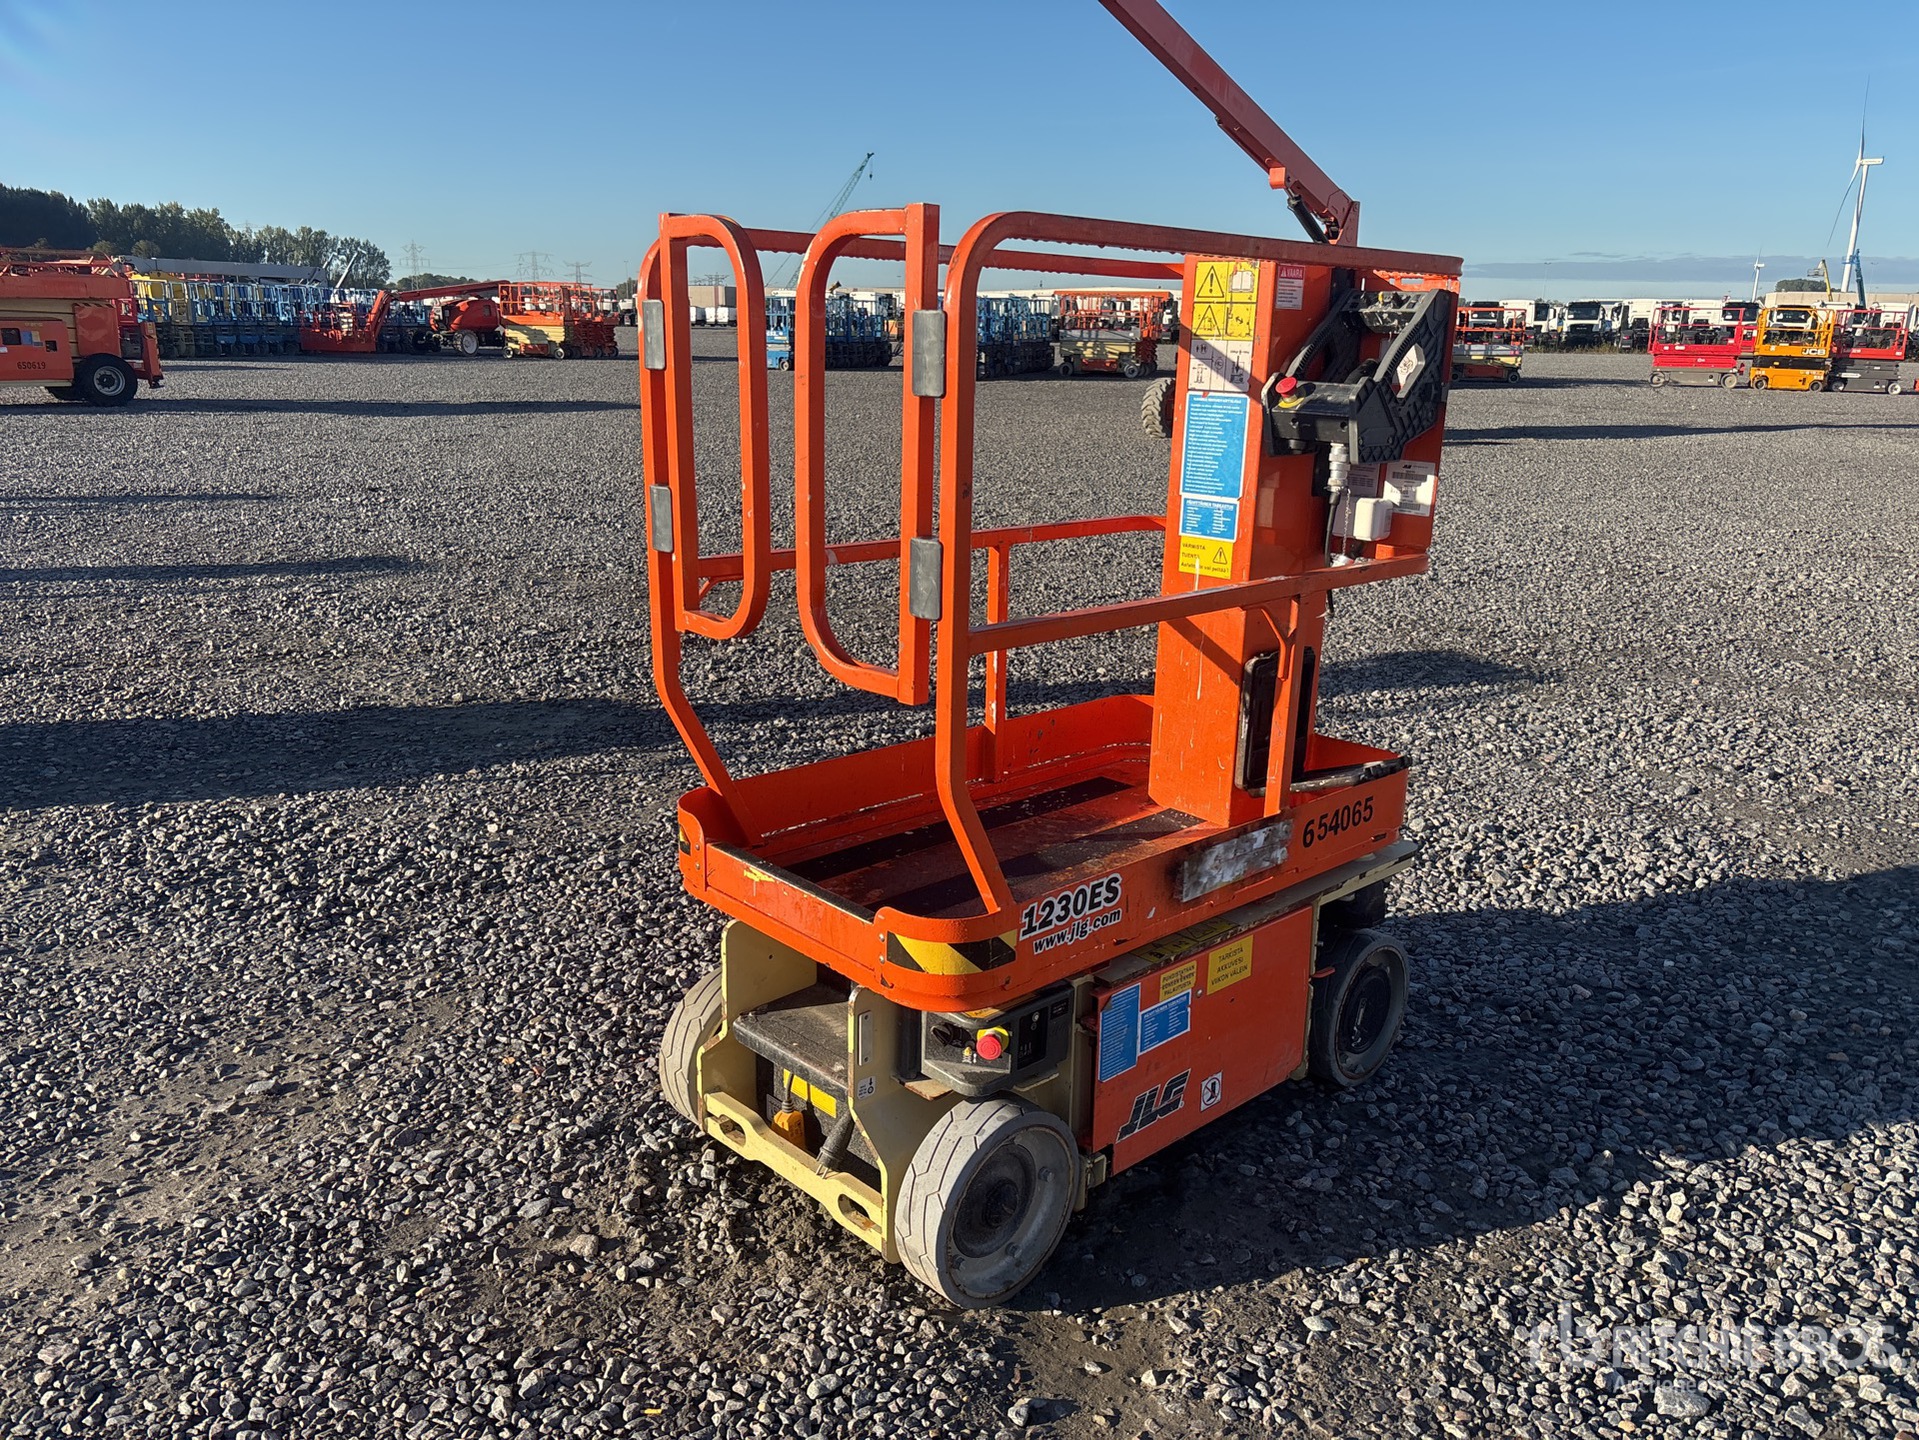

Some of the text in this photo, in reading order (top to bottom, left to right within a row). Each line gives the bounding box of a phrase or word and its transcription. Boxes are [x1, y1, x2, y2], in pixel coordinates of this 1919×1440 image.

[1286, 268, 1303, 278] VAARA
[1802, 348, 1826, 356] JCB
[17, 361, 46, 370] 650619
[1182, 543, 1206, 551] VARMISTA
[1302, 795, 1374, 849] 654065
[1021, 875, 1121, 938] 1230ES
[1034, 909, 1121, 953] www.jlg.com
[1218, 947, 1244, 963] TARKISTA
[1217, 957, 1244, 974] AKKUVESI
[1211, 974, 1229, 986] VIIKON
[1116, 1068, 1191, 1143] JLG
